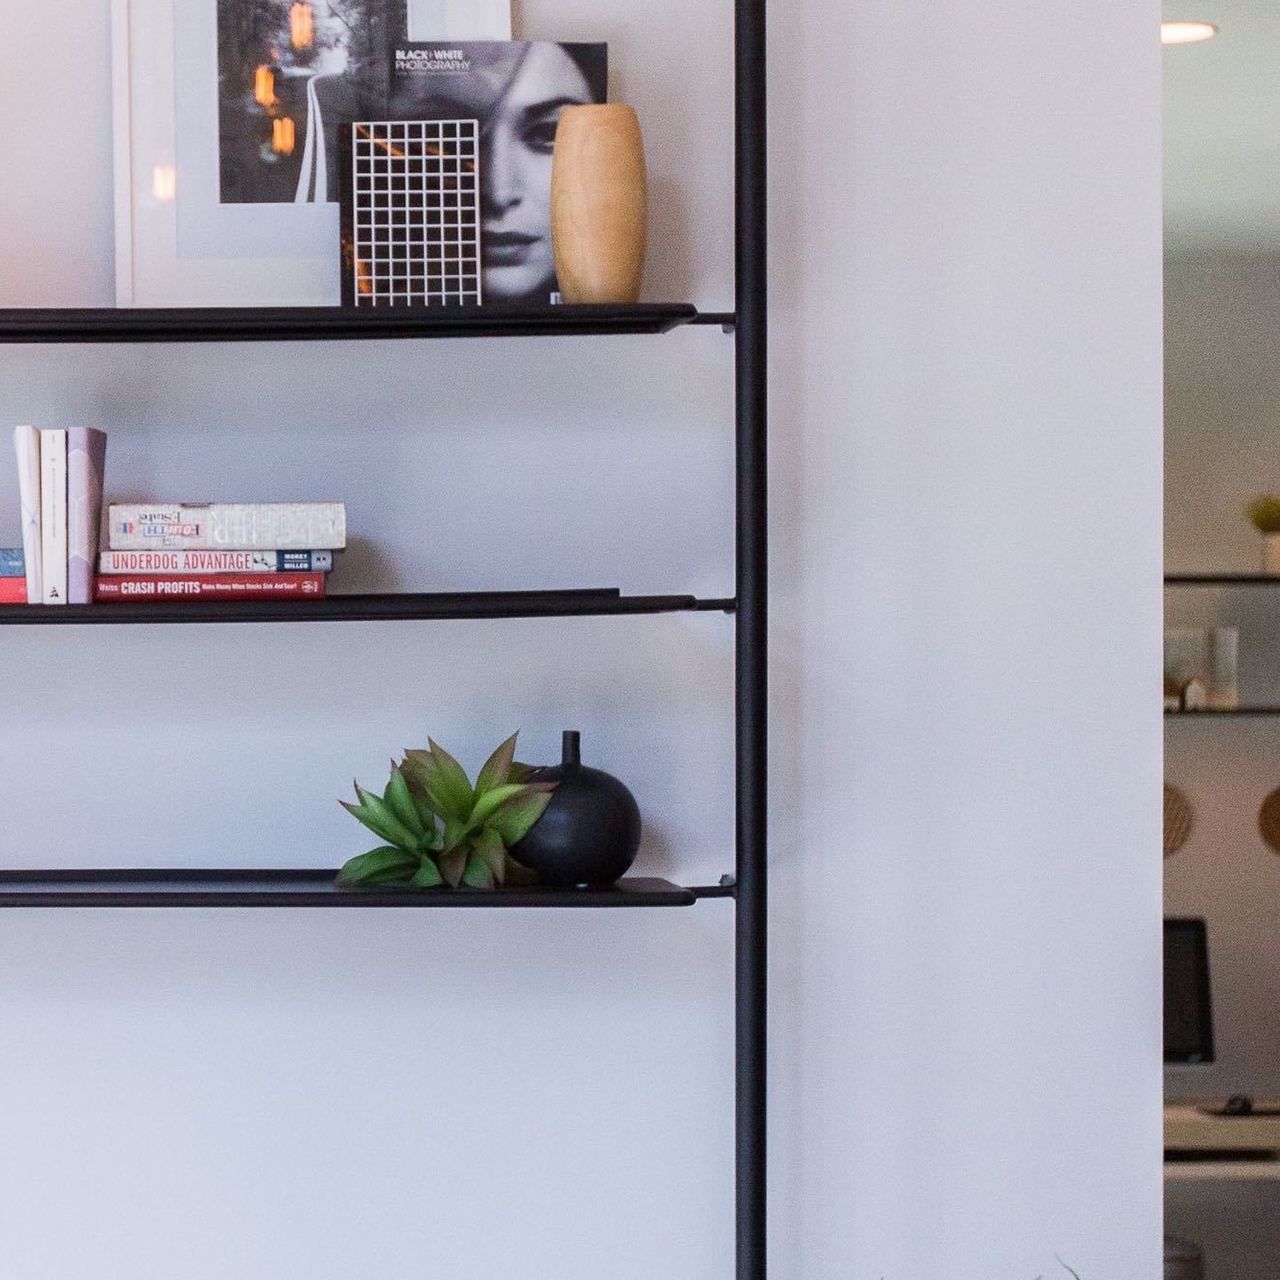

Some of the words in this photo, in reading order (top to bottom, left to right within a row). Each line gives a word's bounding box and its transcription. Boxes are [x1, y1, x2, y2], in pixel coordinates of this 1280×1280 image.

[395, 60, 471, 70] PHOTOGRAPHY
[112, 554, 179, 569] UNDERDOG
[183, 553, 251, 569] ADVANTAGE
[121, 582, 155, 594] CRASH
[157, 582, 201, 594] PROFITS
